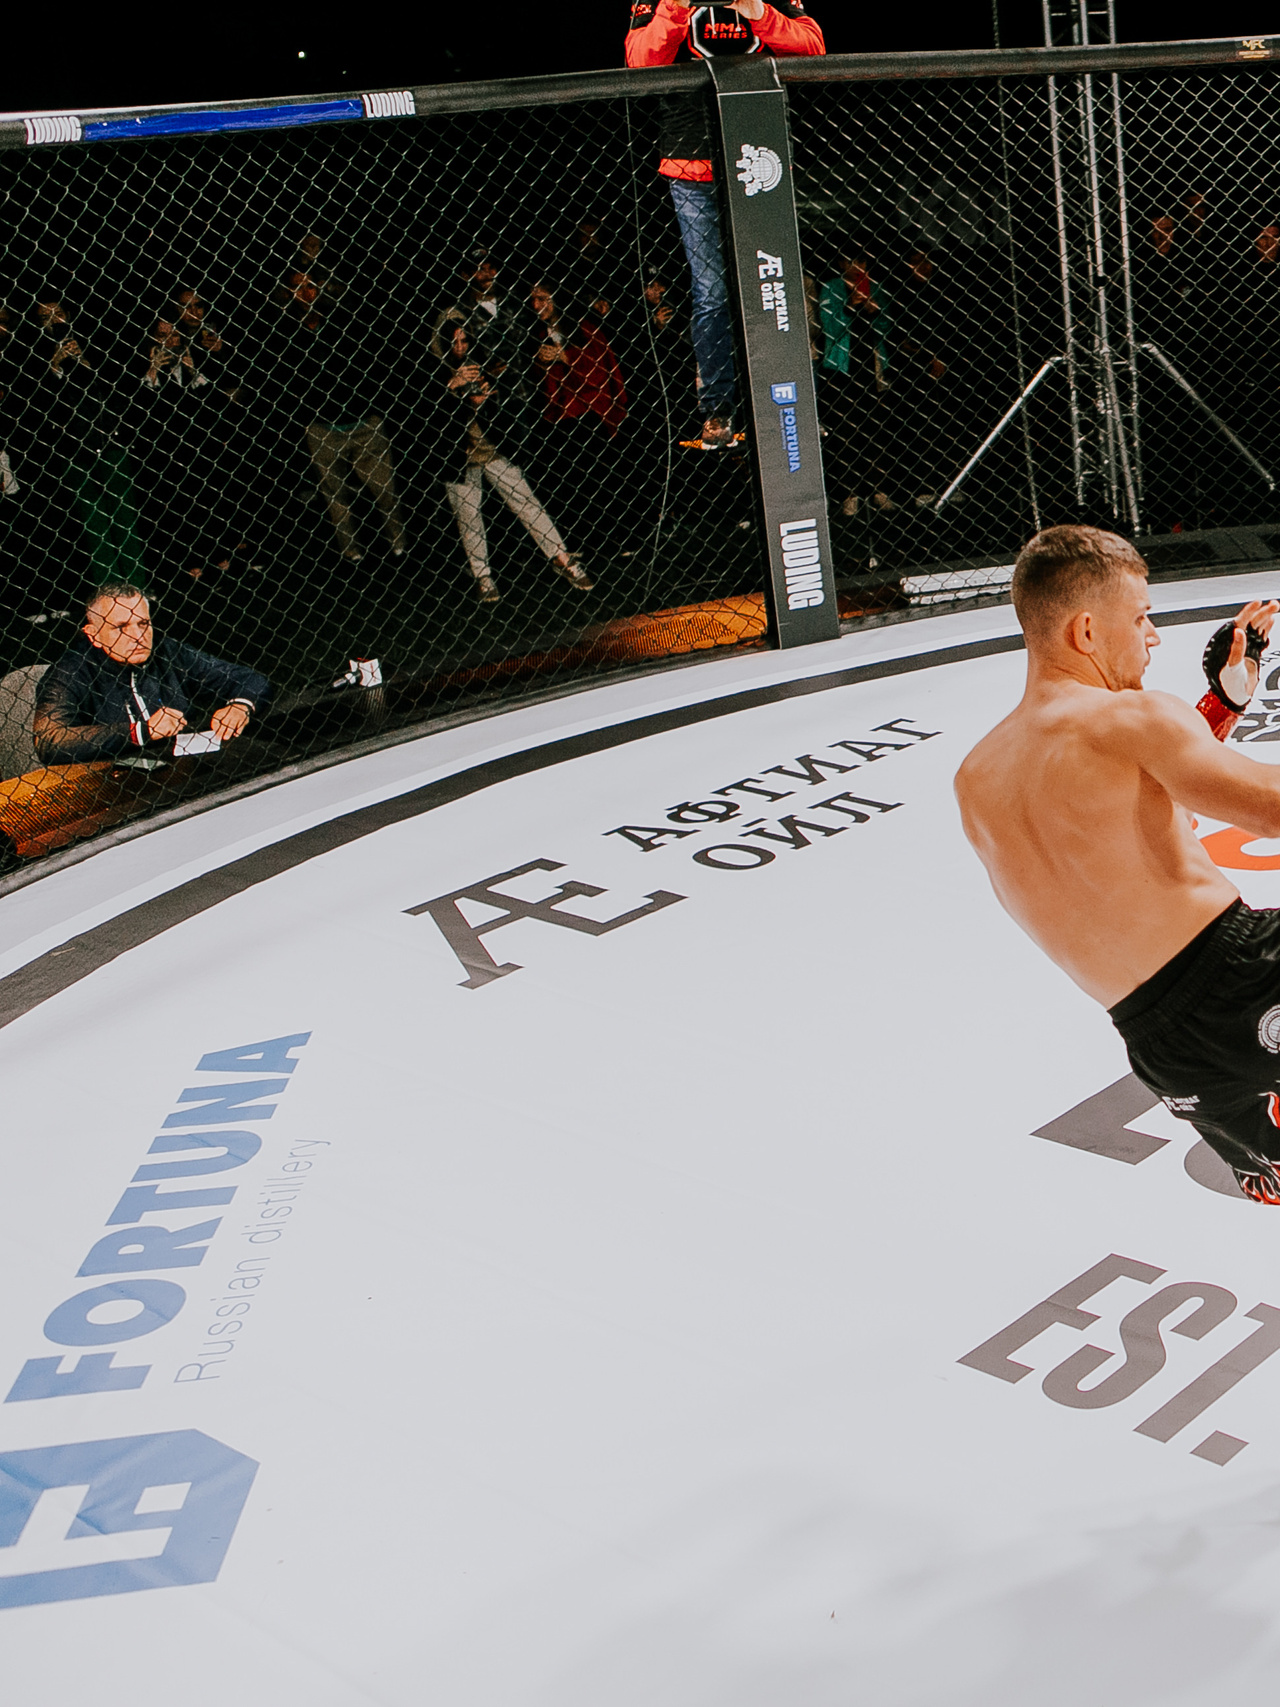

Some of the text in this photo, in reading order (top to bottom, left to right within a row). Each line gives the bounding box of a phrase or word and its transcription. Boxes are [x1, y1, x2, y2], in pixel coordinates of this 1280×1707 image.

[704, 23, 747, 32] MMA
[24, 116, 81, 144] LUDING
[362, 91, 415, 117] LUDING
[783, 407, 801, 473] FORTUNA
[779, 518, 825, 611] LUDING
[601, 718, 944, 852] АФТИАГ
[692, 791, 906, 870] ОЙЛ
[5, 1031, 312, 1401] FORTUNA
[173, 1137, 331, 1384] Russian distillery
